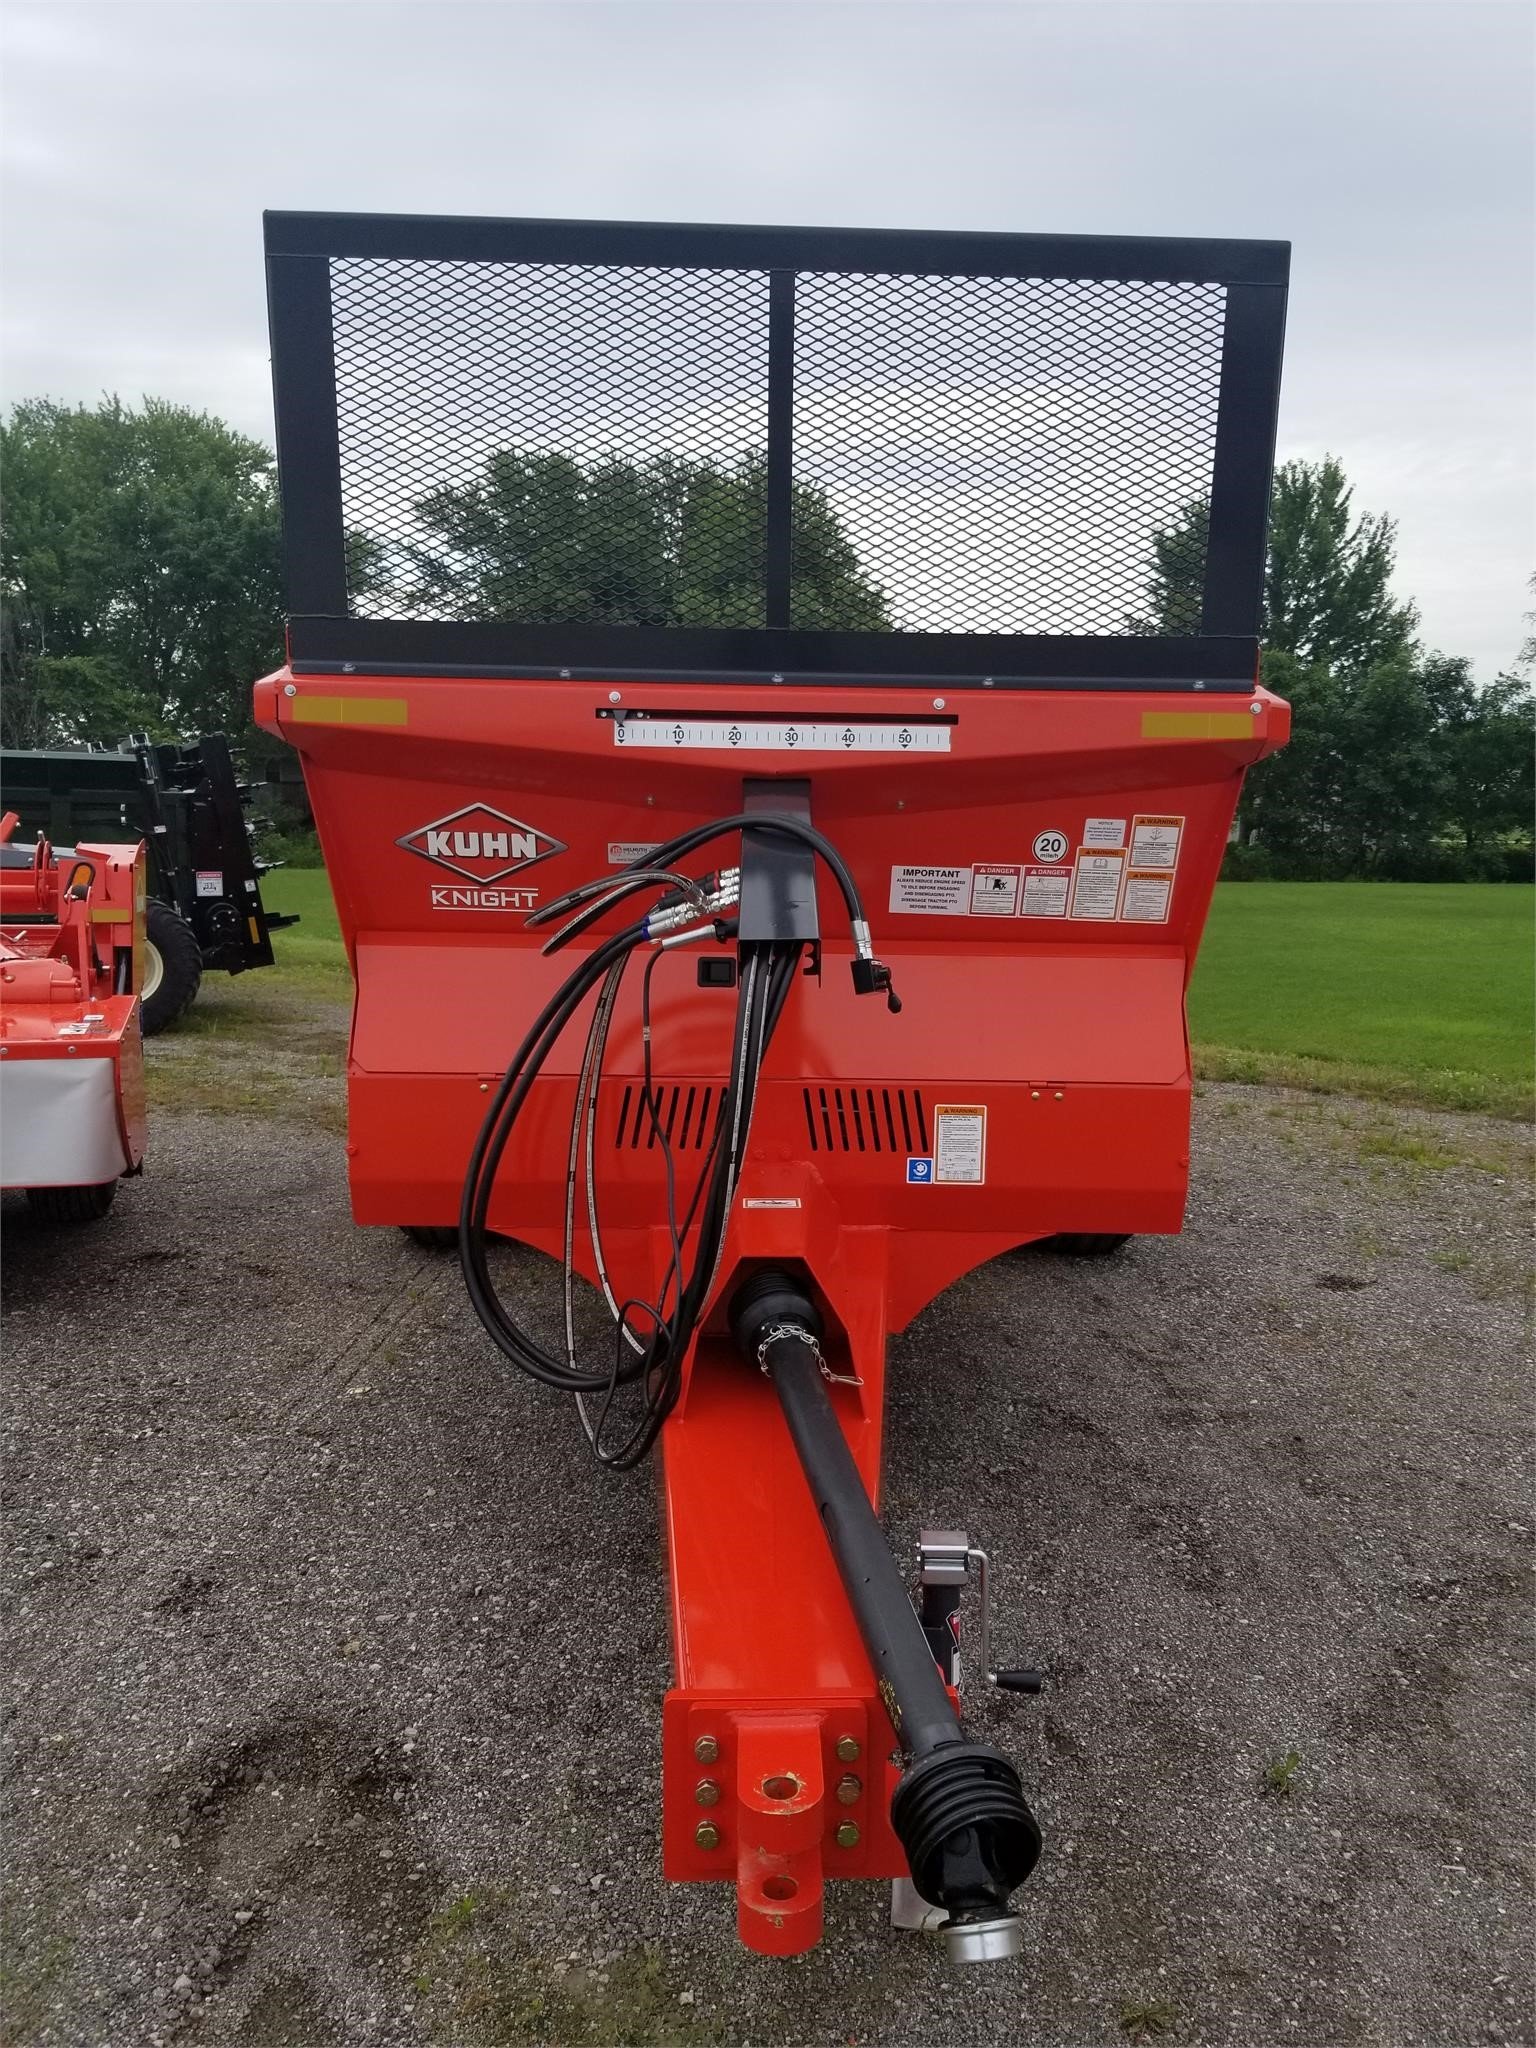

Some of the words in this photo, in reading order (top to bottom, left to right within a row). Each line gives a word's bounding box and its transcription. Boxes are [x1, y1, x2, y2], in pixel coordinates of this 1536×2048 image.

[618, 729, 624, 739] 0
[672, 730, 684, 741] 10
[728, 730, 742, 742] 20
[785, 732, 798, 742] 30
[842, 732, 855, 744] 40
[898, 733, 912, 744] 50
[427, 831, 536, 859] KUHN
[1040, 838, 1062, 852] 20
[903, 869, 960, 878] IMPORTANT
[431, 890, 539, 908] KNIGHT
